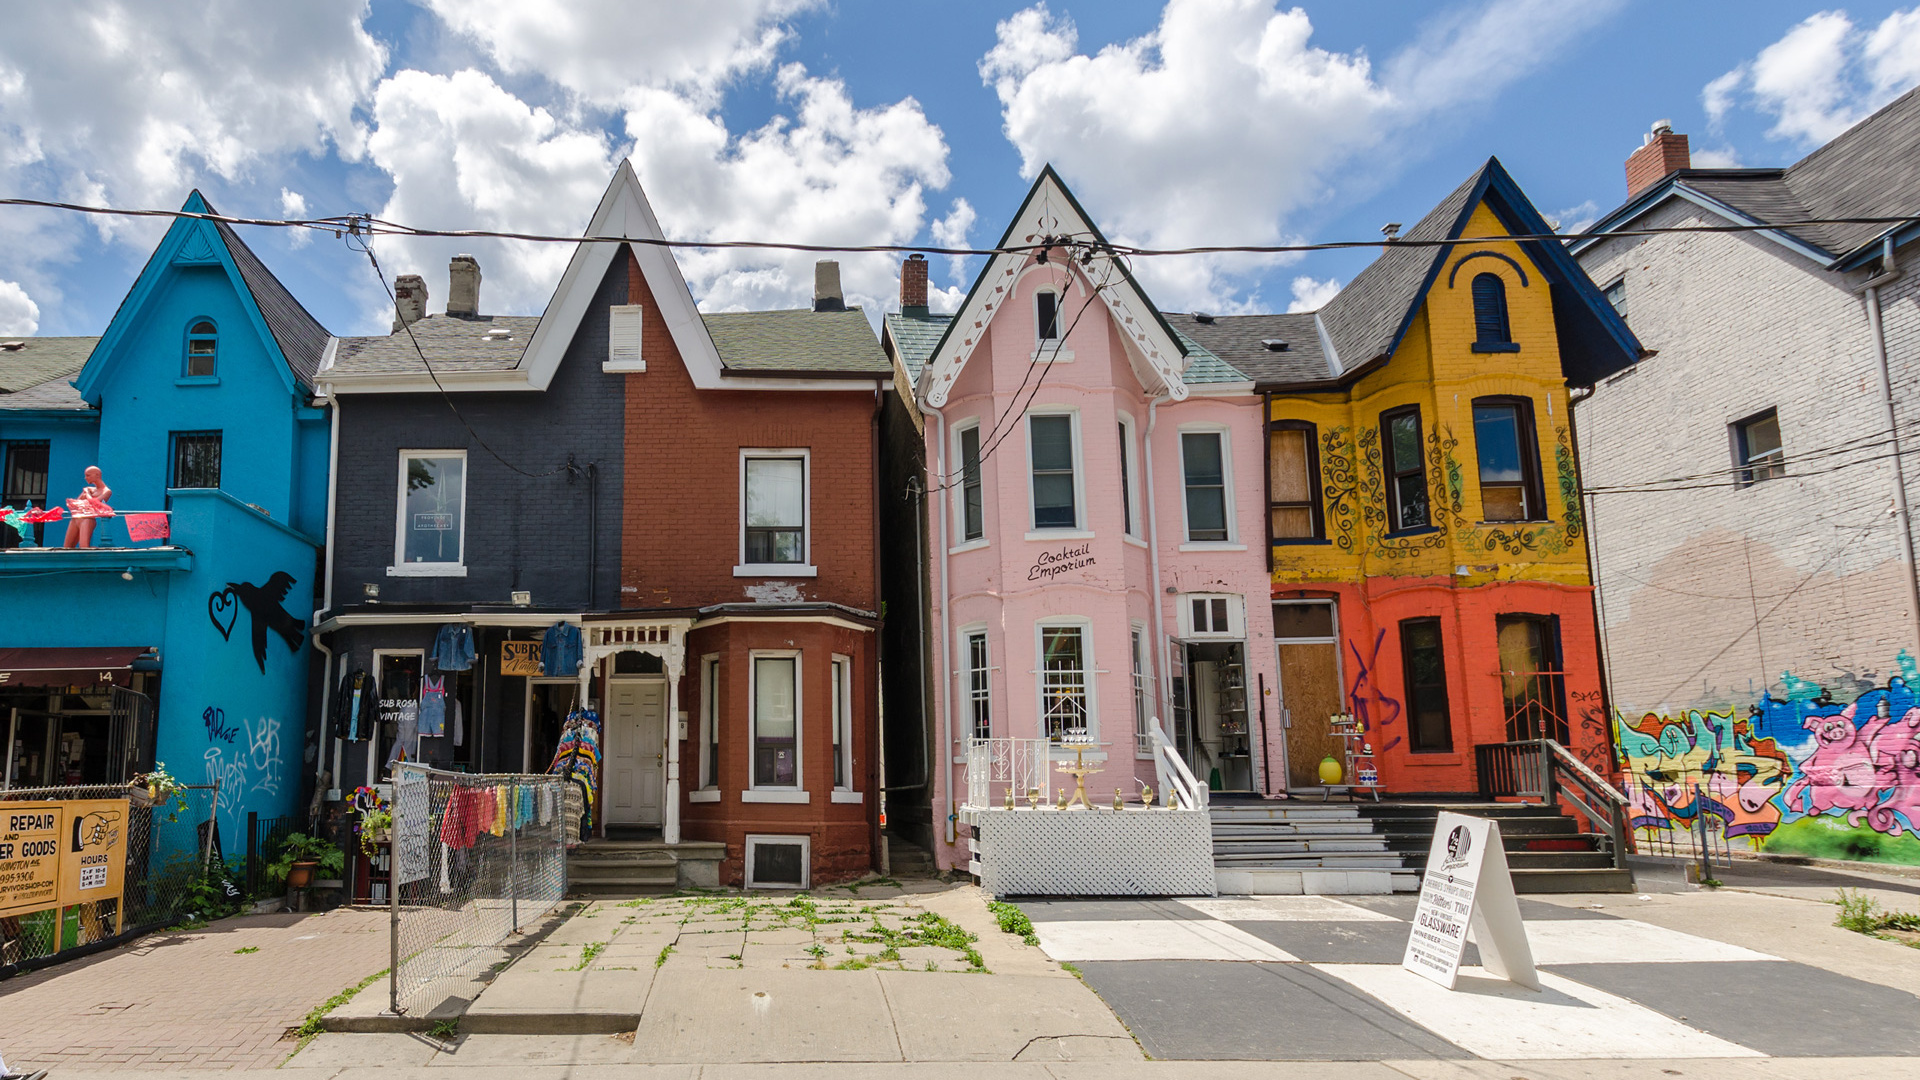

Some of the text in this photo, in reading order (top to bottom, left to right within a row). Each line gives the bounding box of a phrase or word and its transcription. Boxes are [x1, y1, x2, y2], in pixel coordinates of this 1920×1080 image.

[1037, 543, 1090, 566] Cocktail
[1027, 557, 1096, 581] Emporium
[100, 671, 113, 682] 14
[379, 699, 418, 709] SUB ROSA
[380, 711, 416, 721] VINTAGE
[10, 815, 55, 831] REPAIR
[3, 833, 19, 841] AND
[22, 840, 56, 857] GOODS
[81, 854, 108, 865] HOURS
[1454, 901, 1469, 915] TIKI
[1420, 913, 1461, 939] GLASSWARE
[1413, 928, 1428, 939] WINE
